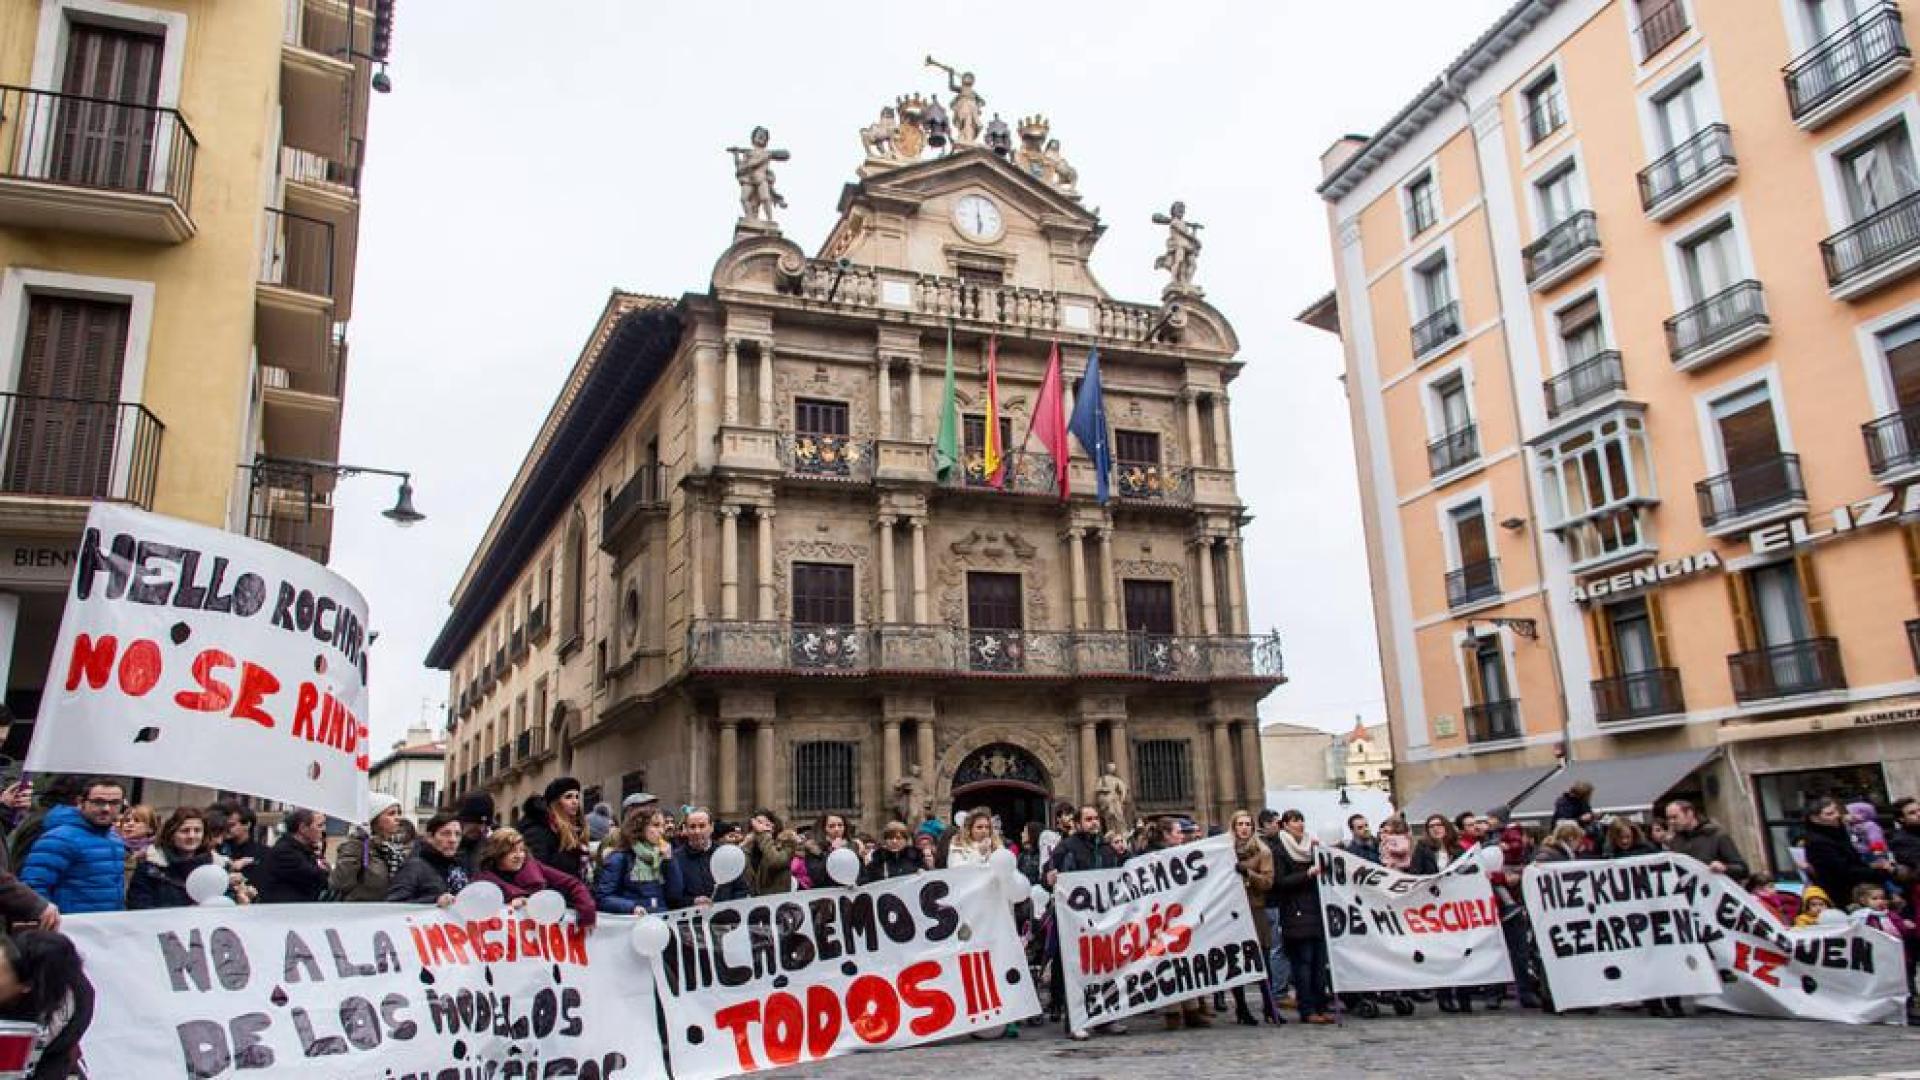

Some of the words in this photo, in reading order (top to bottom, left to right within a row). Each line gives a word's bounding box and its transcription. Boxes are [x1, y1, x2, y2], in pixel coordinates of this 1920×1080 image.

[76, 527, 266, 617] HELLO
[1568, 551, 1722, 604] AGENCIA
[66, 633, 162, 696] NO
[174, 649, 281, 728] SE
[1067, 850, 1208, 913] QUEREMOS
[1318, 851, 1347, 887] NO
[1326, 902, 1367, 938] DE
[1370, 903, 1404, 935] MI
[157, 926, 250, 992] NO
[284, 929, 325, 983] A
[325, 928, 401, 978] LA
[1084, 978, 1120, 1018] EN
[176, 1011, 275, 1078] DE
[291, 992, 418, 1057] LOS
[425, 987, 583, 1040] MODELOS
